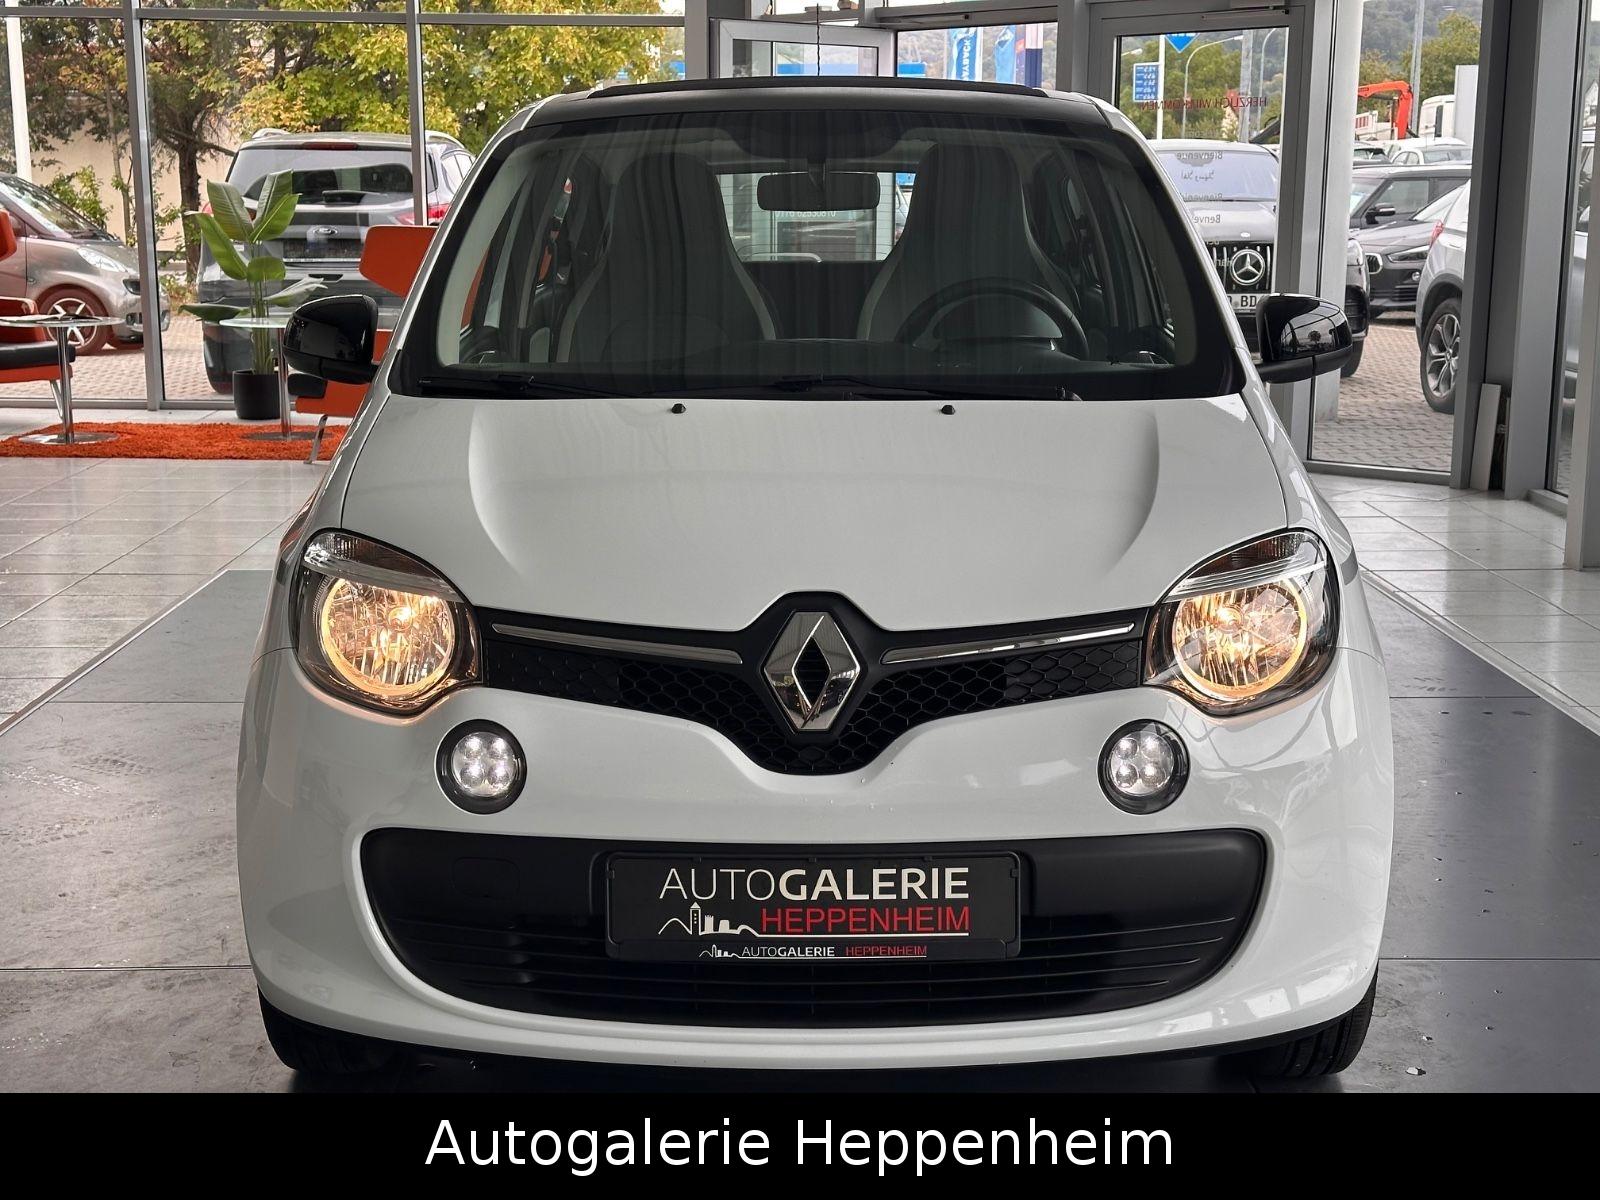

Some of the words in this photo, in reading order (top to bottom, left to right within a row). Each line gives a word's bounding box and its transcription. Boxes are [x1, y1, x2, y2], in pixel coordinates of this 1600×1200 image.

[659, 867, 970, 901] AUTOGALERIE
[761, 906, 970, 932] HEPPENHEIM
[741, 946, 835, 957] AUTOGALERIE
[845, 945, 927, 956] HEPPENHEIM
